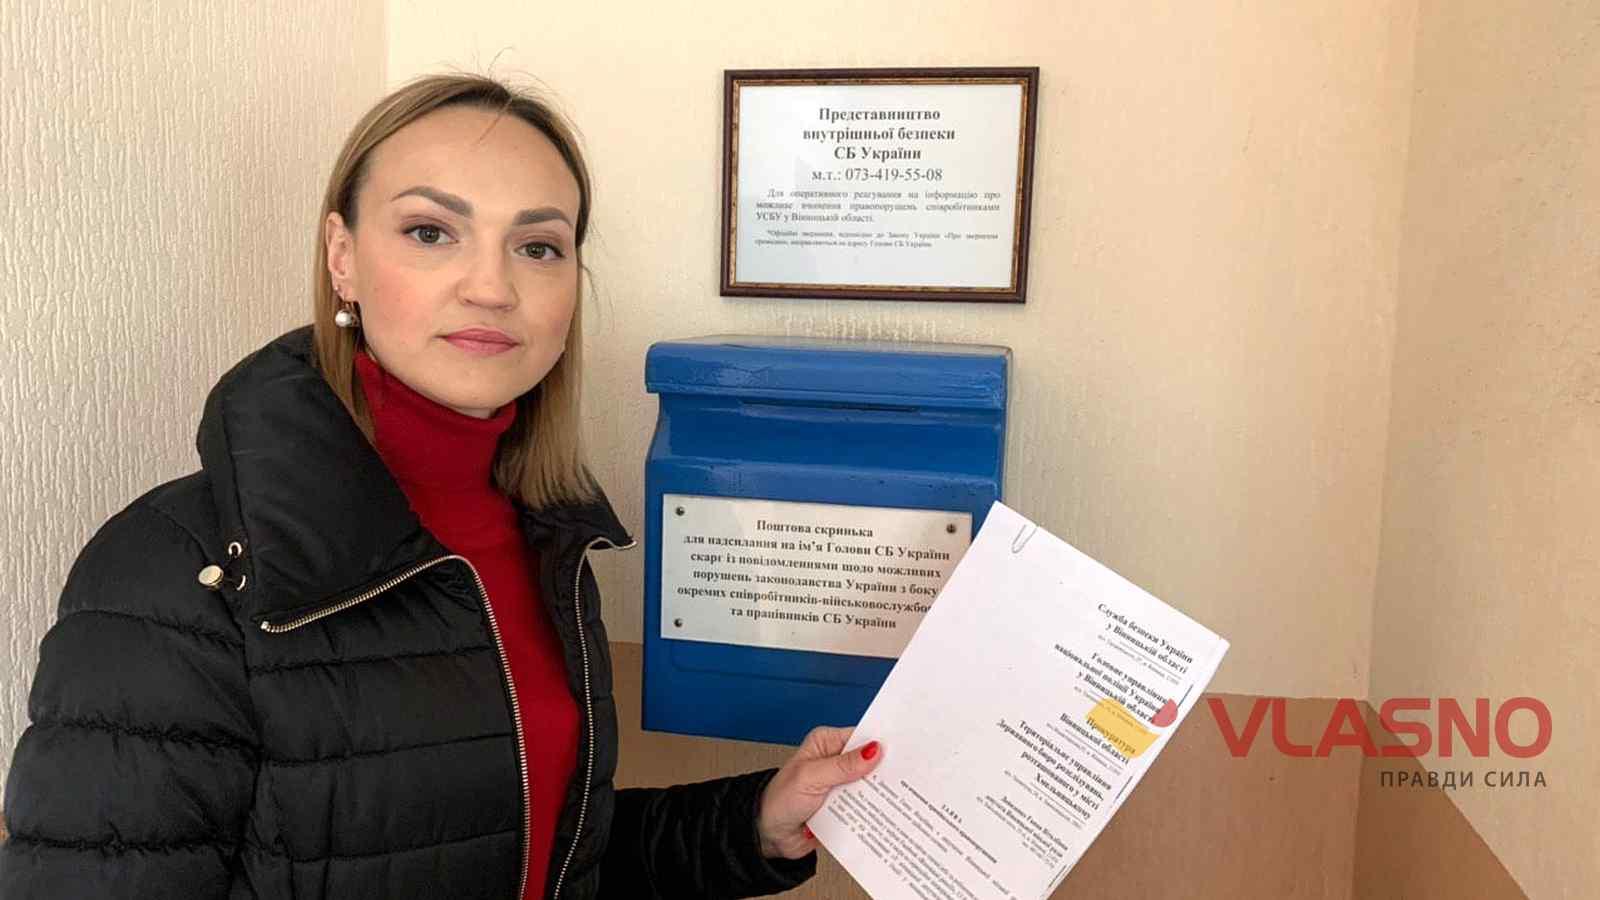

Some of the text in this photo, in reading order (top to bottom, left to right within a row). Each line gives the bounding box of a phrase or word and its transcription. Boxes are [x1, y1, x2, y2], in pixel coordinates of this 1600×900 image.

[819, 107, 941, 123] Представництво
[802, 127, 956, 143] внутрішньої безпеки
[833, 147, 921, 163] СБ України
[812, 168, 943, 181] м.т.: 073-419-55-08
[767, 189, 784, 199] Для
[984, 191, 1000, 201] про
[757, 519, 874, 539] Поштова скринька
[683, 535, 704, 545] для
[707, 537, 777, 550] надсилання
[780, 540, 795, 549] на
[826, 542, 871, 555] Голови
[875, 546, 894, 556] СБ
[898, 547, 950, 561] України
[690, 553, 941, 578] скарг із повідомленнями щодо можливих
[693, 570, 752, 583] порушень
[754, 574, 842, 589] законодавства
[845, 578, 899, 594] України
[910, 584, 938, 597] боку
[677, 587, 726, 599] окремих
[730, 608, 896, 629] та працівників СБ України
